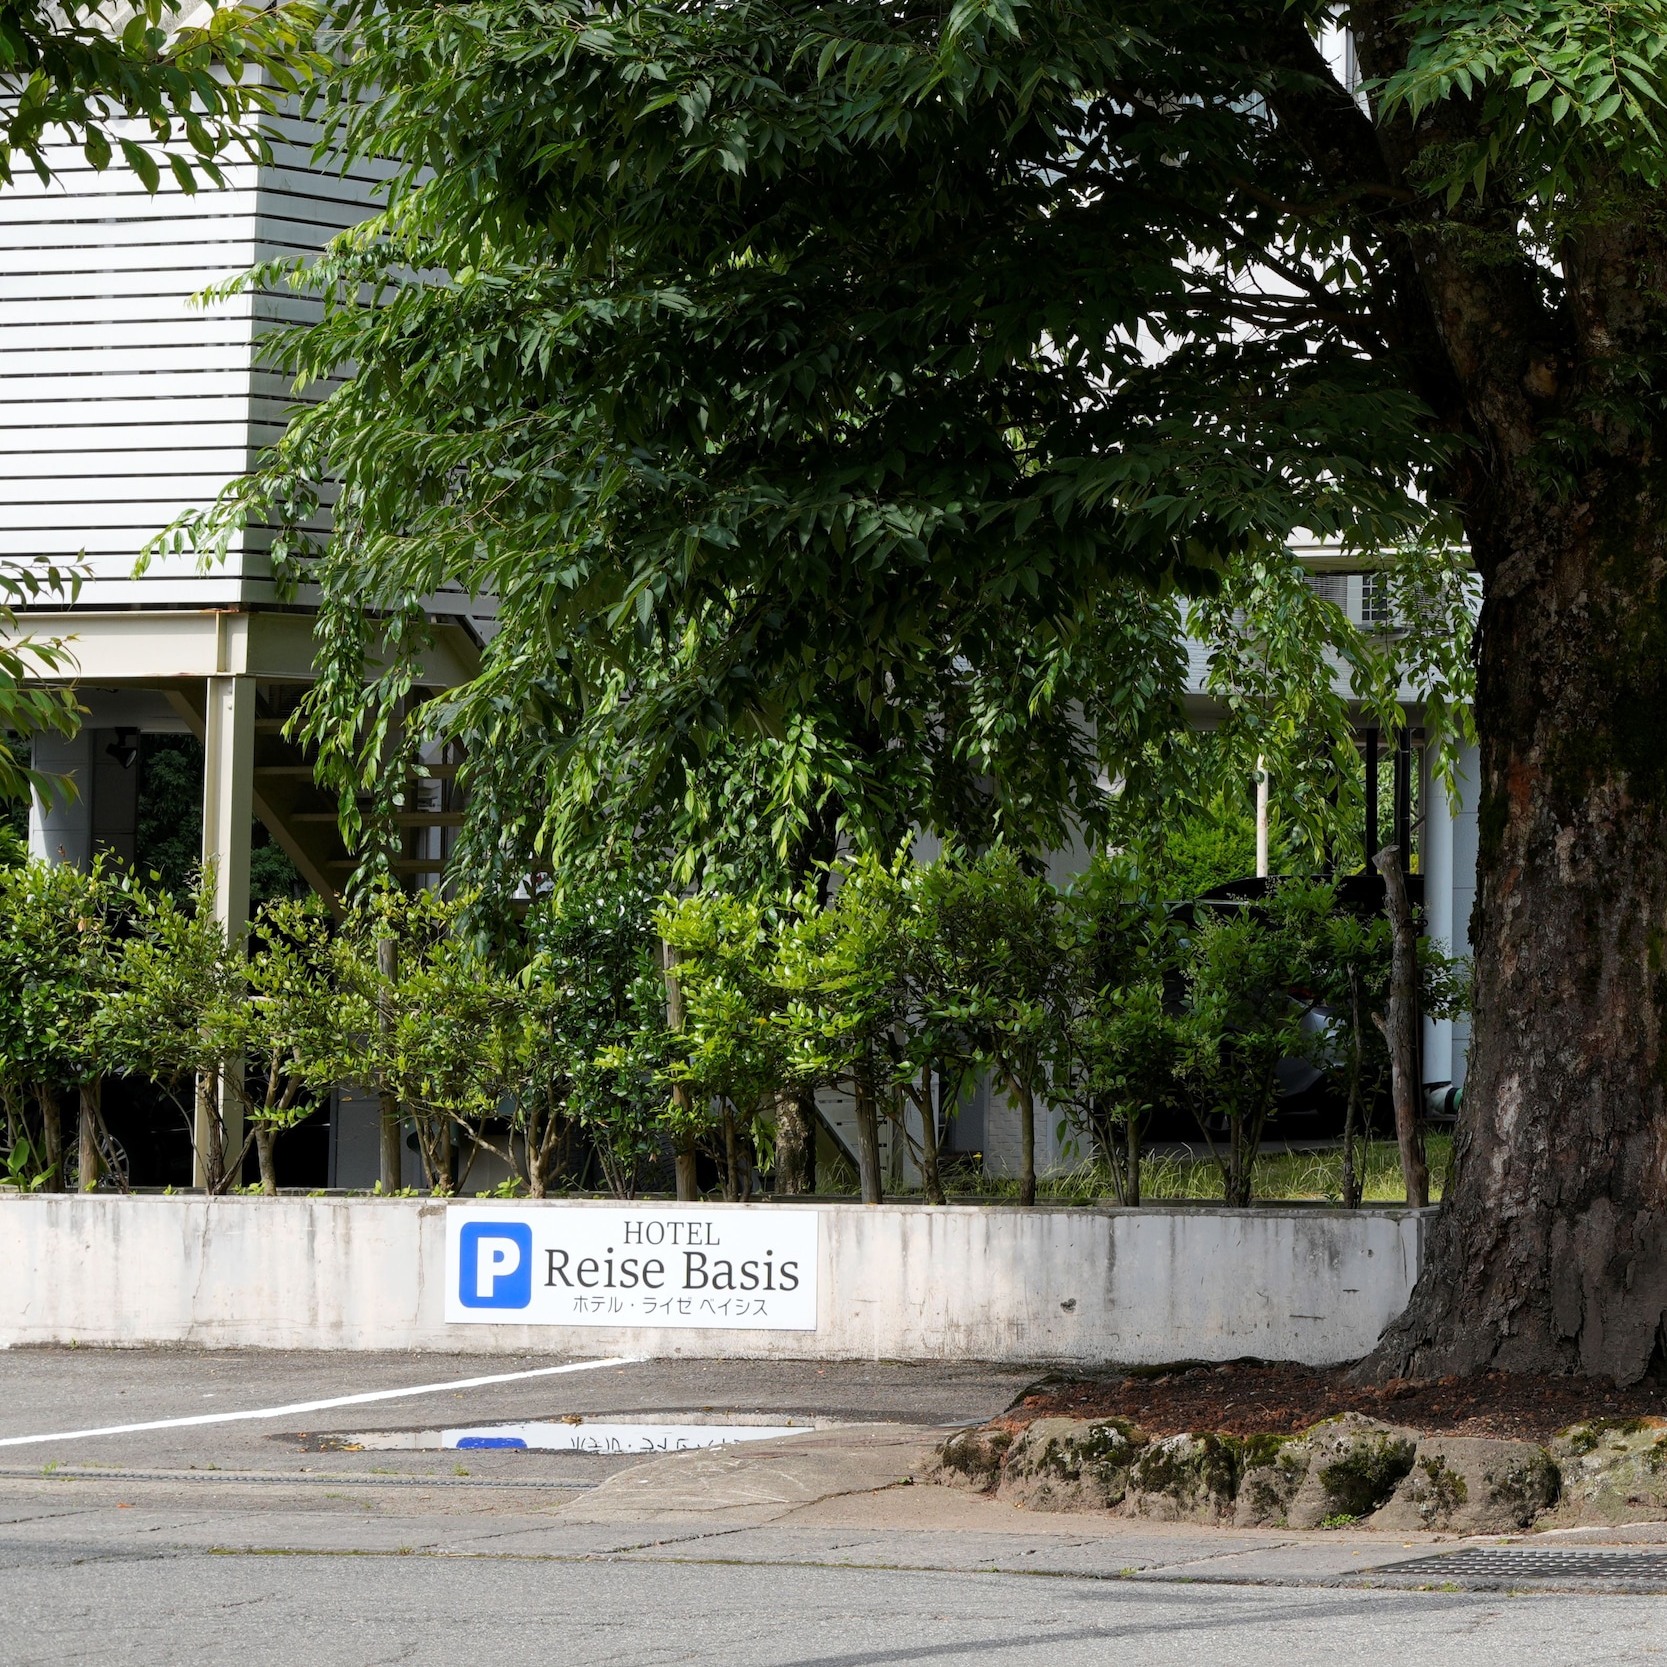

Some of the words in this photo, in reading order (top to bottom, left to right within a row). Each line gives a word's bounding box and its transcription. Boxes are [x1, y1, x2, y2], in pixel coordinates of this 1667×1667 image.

[623, 1221, 720, 1246] HOTEL
[476, 1237, 521, 1298] P
[544, 1247, 665, 1289] Reise
[682, 1249, 799, 1291] Basis
[700, 1297, 768, 1316] ベイシス
